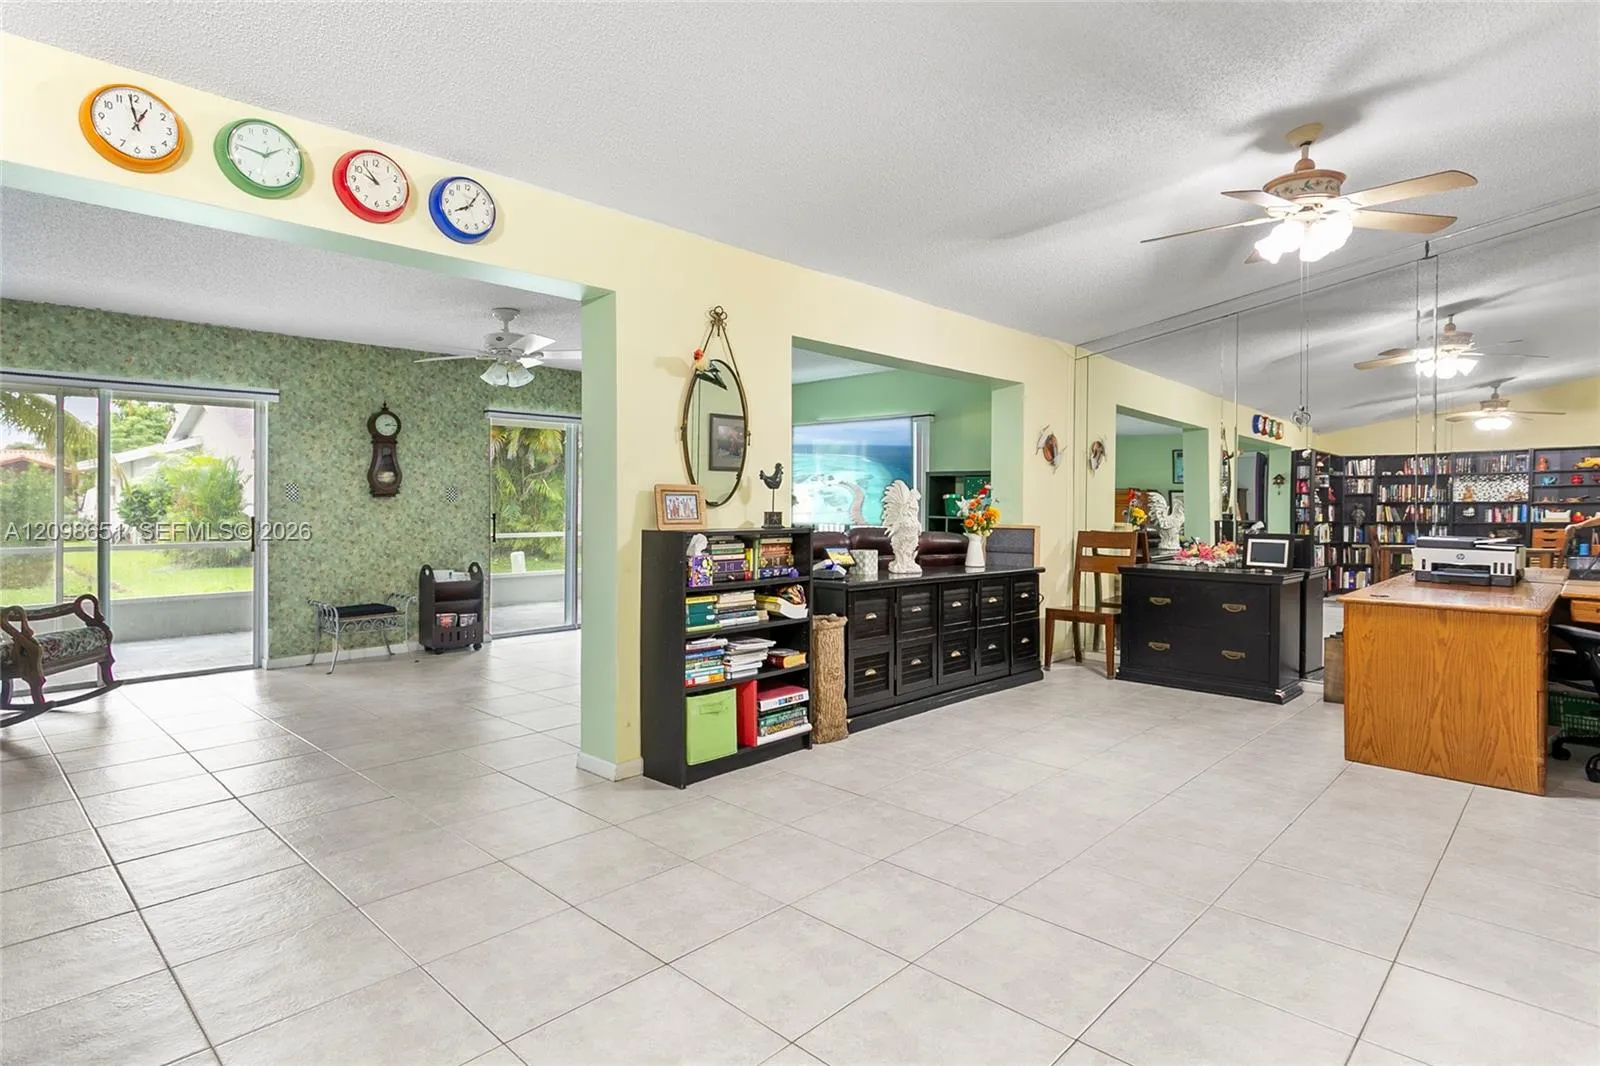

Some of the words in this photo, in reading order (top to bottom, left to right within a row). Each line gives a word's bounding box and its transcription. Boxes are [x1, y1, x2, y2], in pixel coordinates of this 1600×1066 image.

[116, 94, 122, 103] 11
[104, 100, 113, 109] 10
[98, 112, 105, 120] 9
[160, 113, 166, 121] 2
[120, 139, 126, 147] 7
[355, 165, 362, 173] 10
